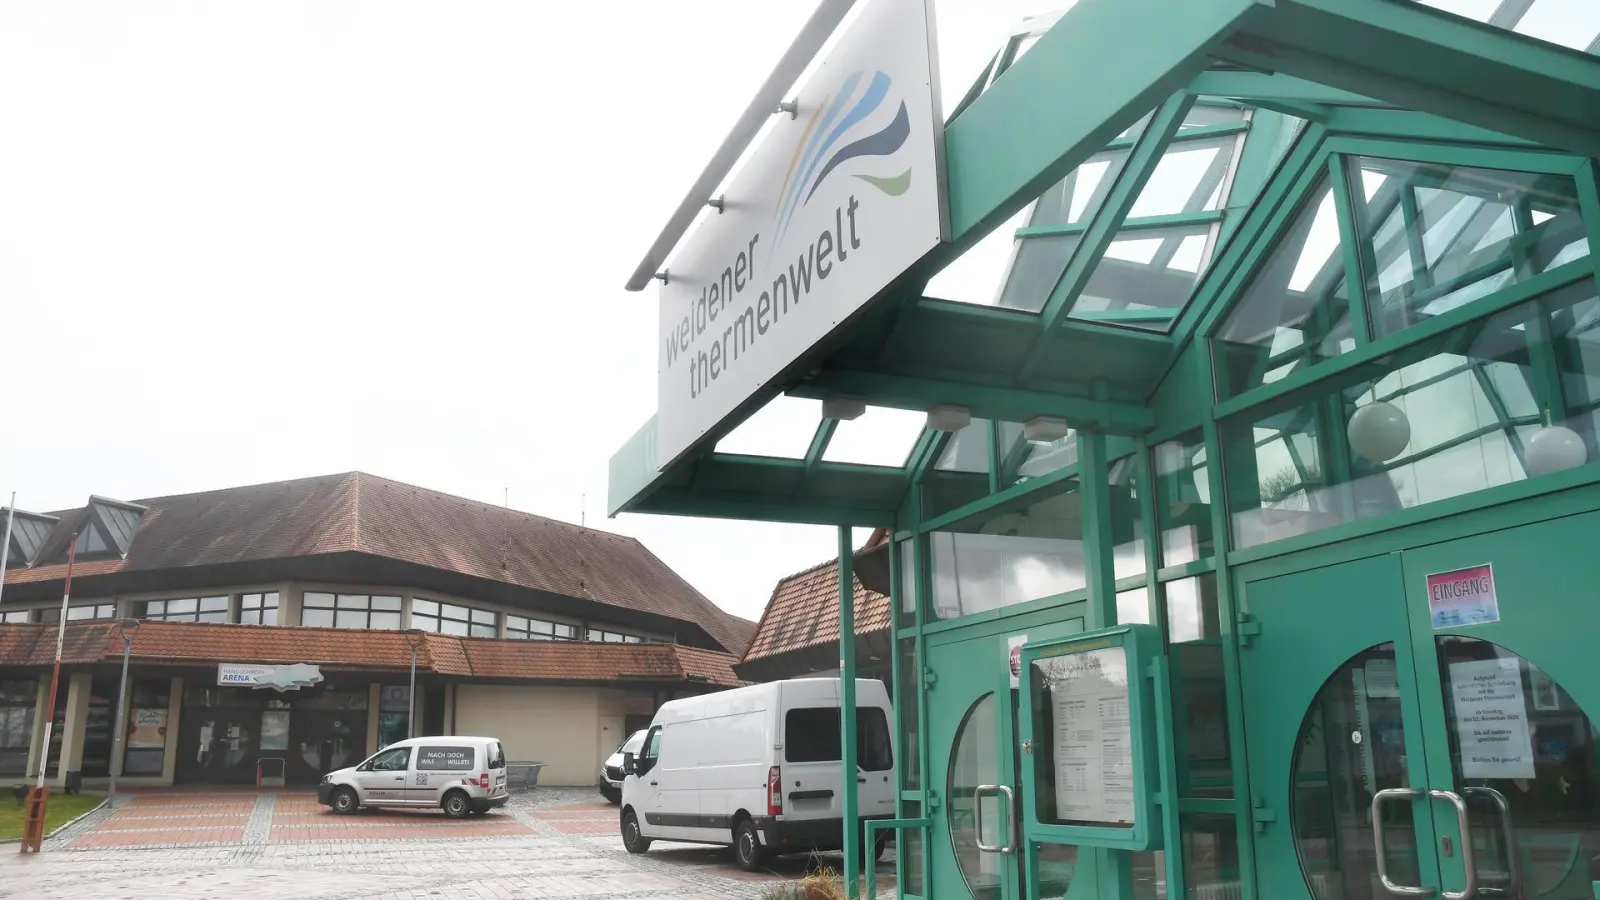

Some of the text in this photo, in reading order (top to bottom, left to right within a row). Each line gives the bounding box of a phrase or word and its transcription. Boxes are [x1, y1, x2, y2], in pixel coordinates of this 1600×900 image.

[666, 233, 760, 369] weidener
[689, 194, 861, 399] thermenwelt
[1432, 576, 1489, 602] EINGANG
[222, 674, 250, 682] ARENA
